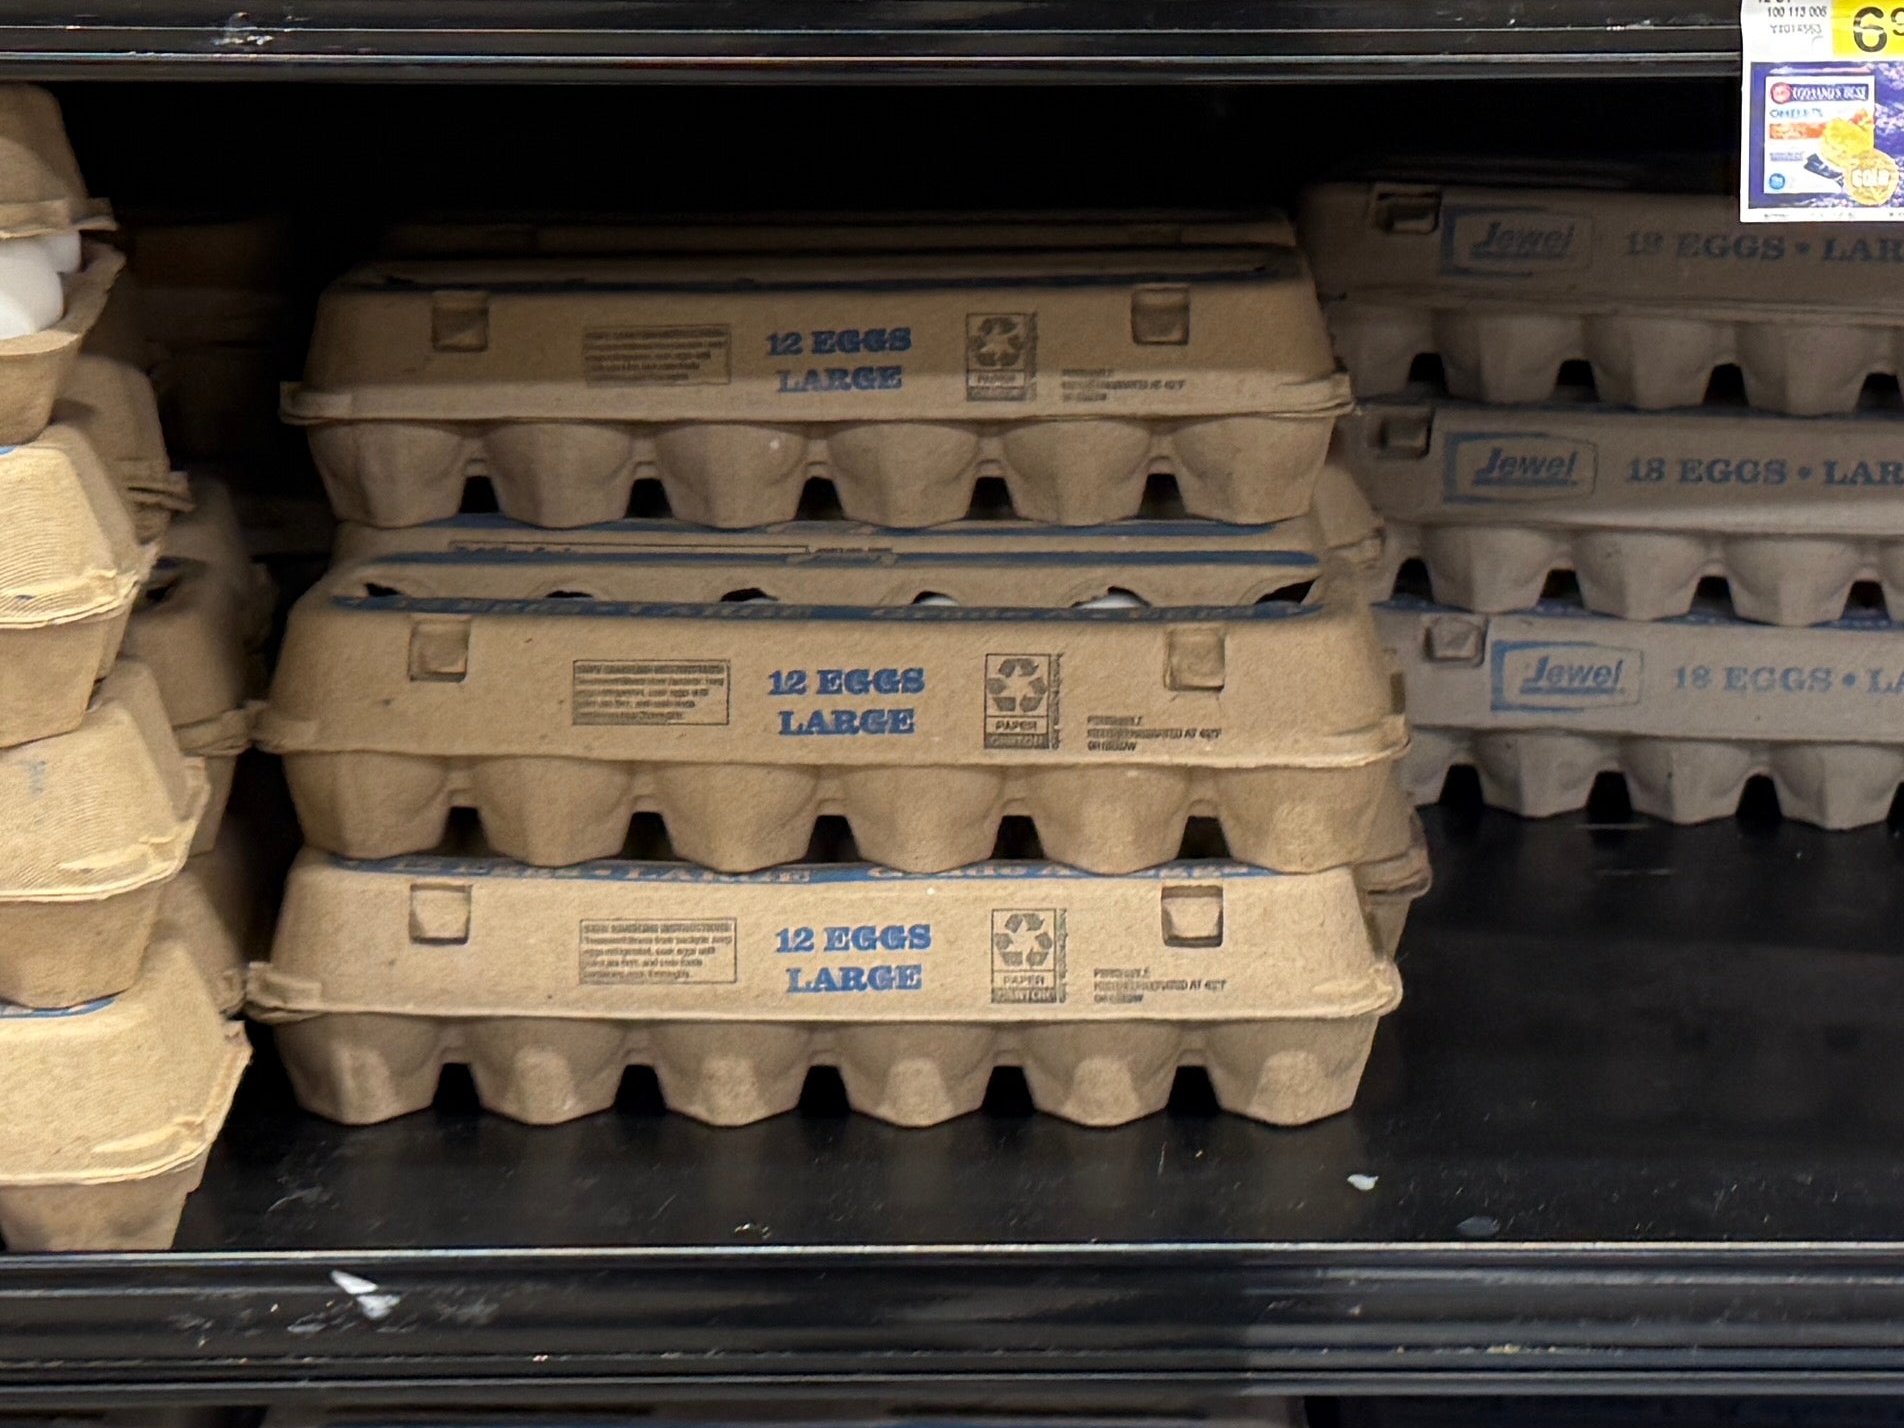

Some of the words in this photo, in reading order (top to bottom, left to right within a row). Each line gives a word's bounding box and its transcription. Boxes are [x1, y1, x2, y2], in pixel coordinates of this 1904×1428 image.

[1476, 448, 1576, 478] Jewel
[1626, 457, 1666, 484] 18
[1679, 459, 1788, 486] EGGS
[767, 669, 808, 696] 12
[816, 667, 925, 695] EGGS
[778, 708, 915, 736] LARGE
